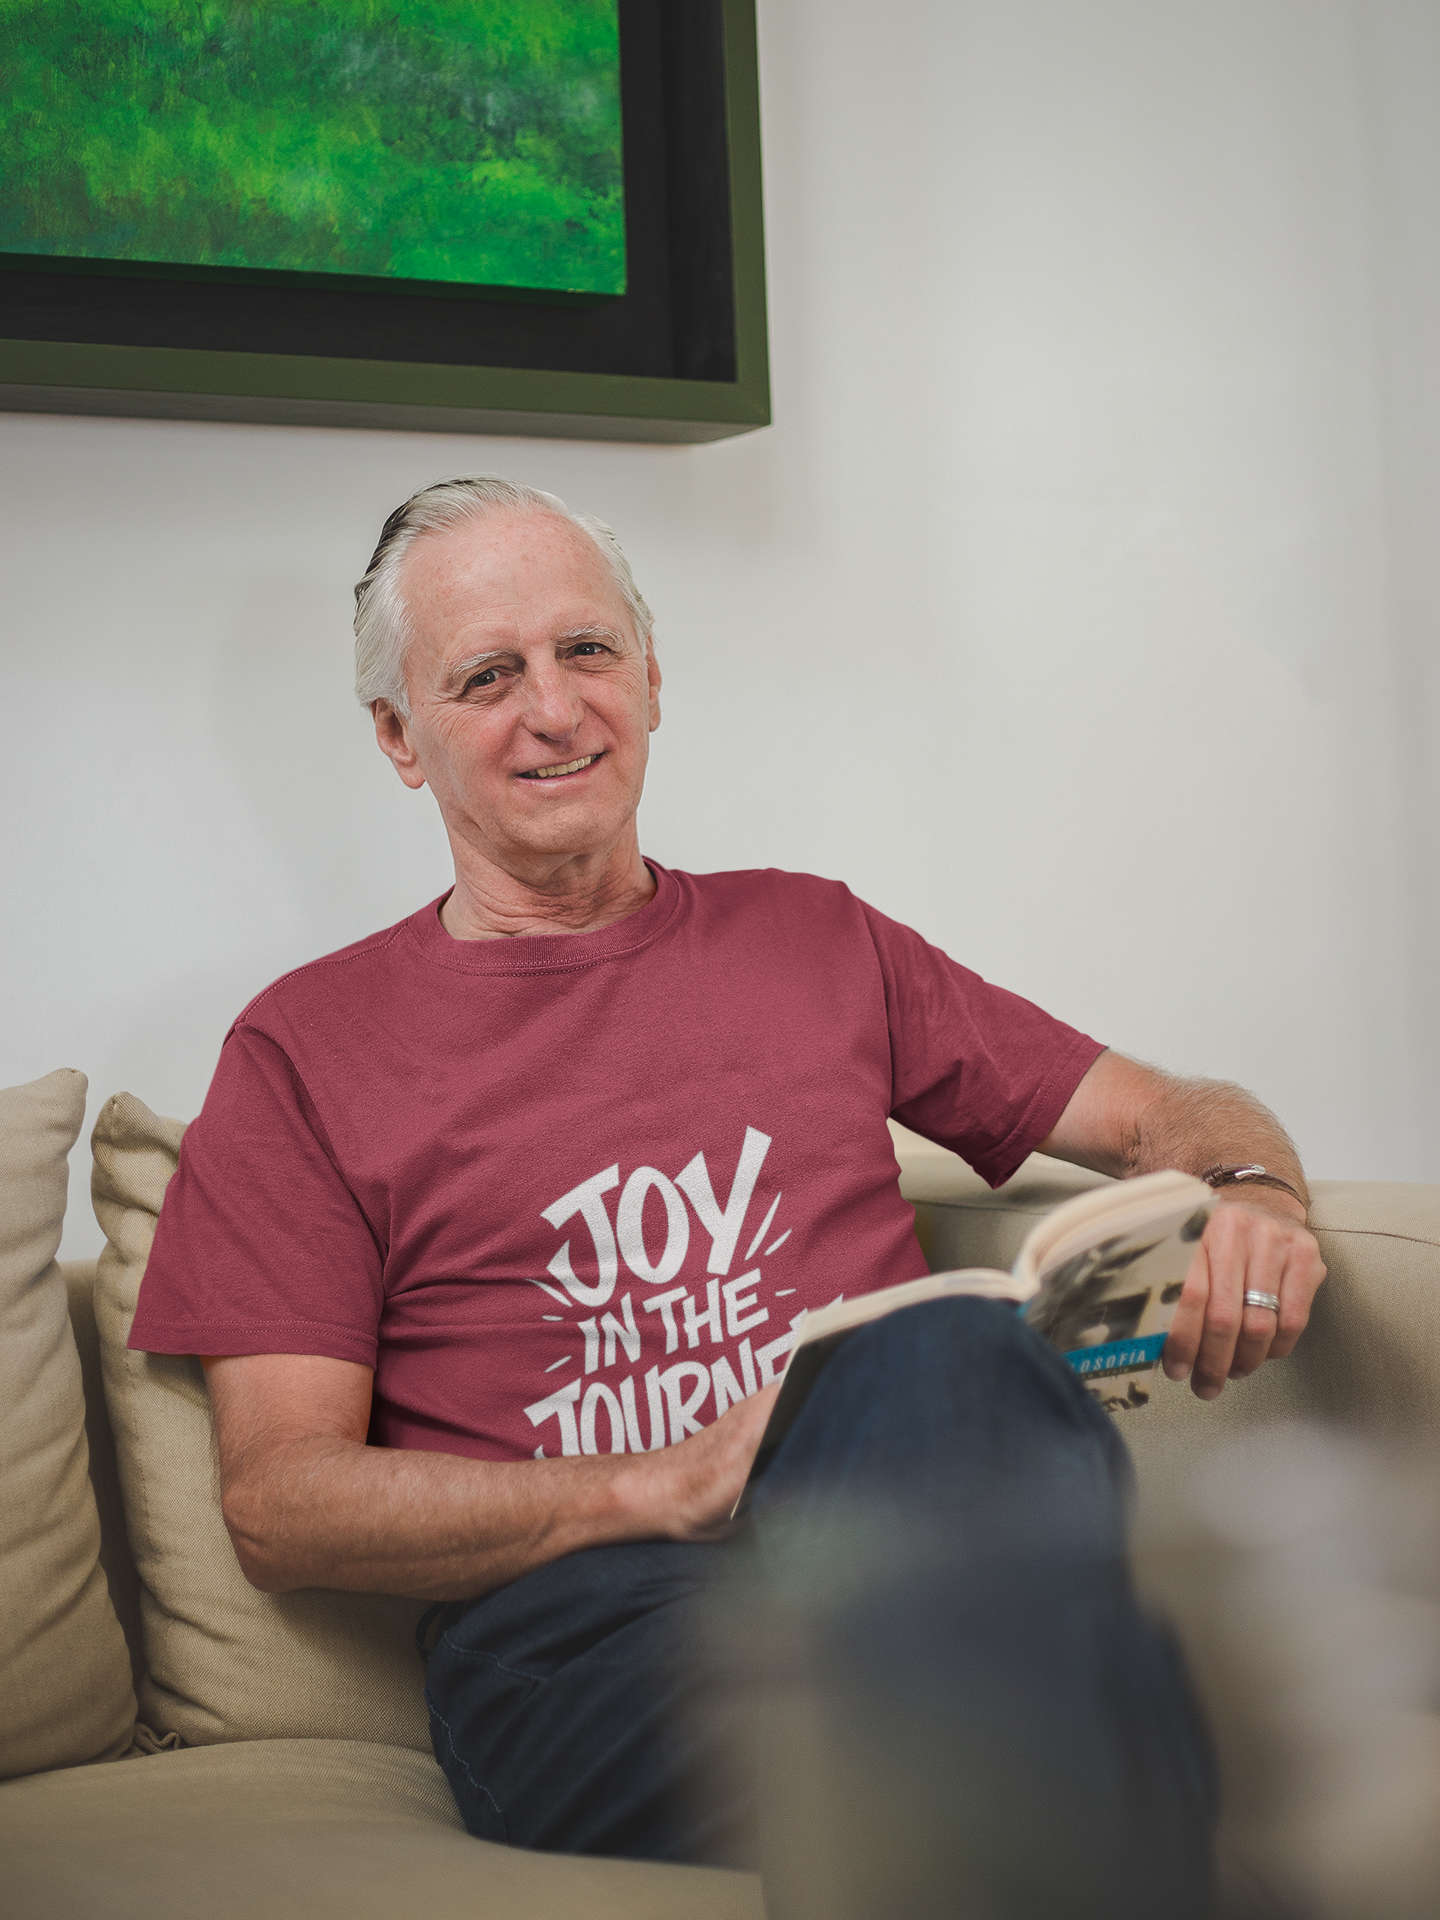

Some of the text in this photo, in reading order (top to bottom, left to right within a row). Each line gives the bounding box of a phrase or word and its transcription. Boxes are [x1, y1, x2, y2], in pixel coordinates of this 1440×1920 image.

[540, 1125, 772, 1307] JOY
[523, 1294, 843, 1460] JOURNE
[577, 1268, 769, 1375] IN THE
